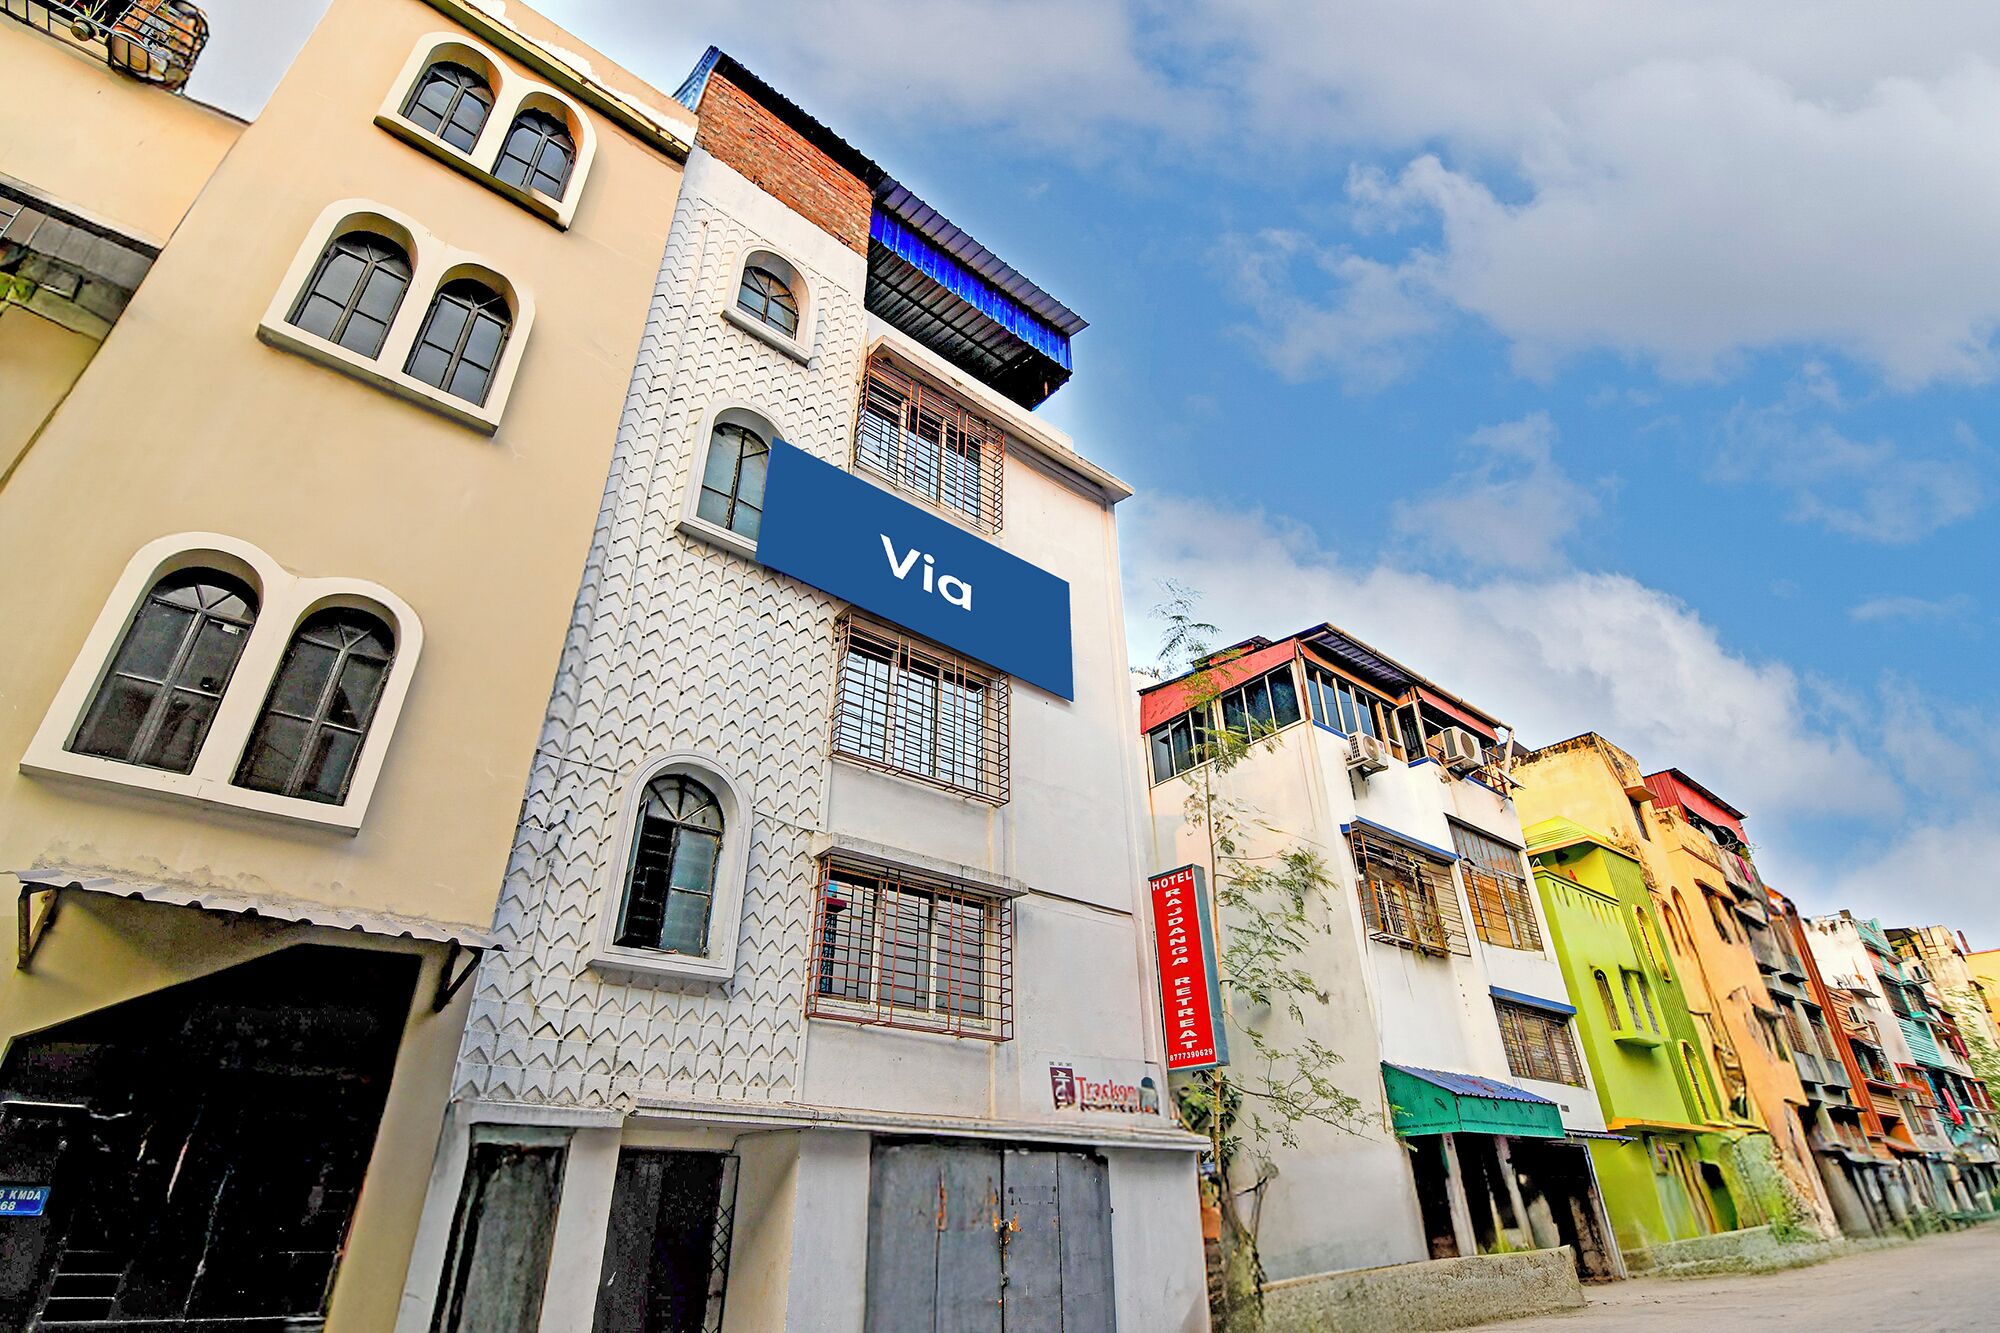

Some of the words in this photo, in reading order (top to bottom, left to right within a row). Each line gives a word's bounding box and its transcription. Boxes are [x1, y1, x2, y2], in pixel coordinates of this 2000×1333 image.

[880, 533, 972, 612] Via
[1152, 870, 1192, 891] HOTEL
[1165, 888, 1189, 966] RAJDANGA
[1174, 977, 1198, 1049] RETREAT
[1169, 1048, 1213, 1062] 8777390629
[8, 1190, 41, 1200] KMDA
